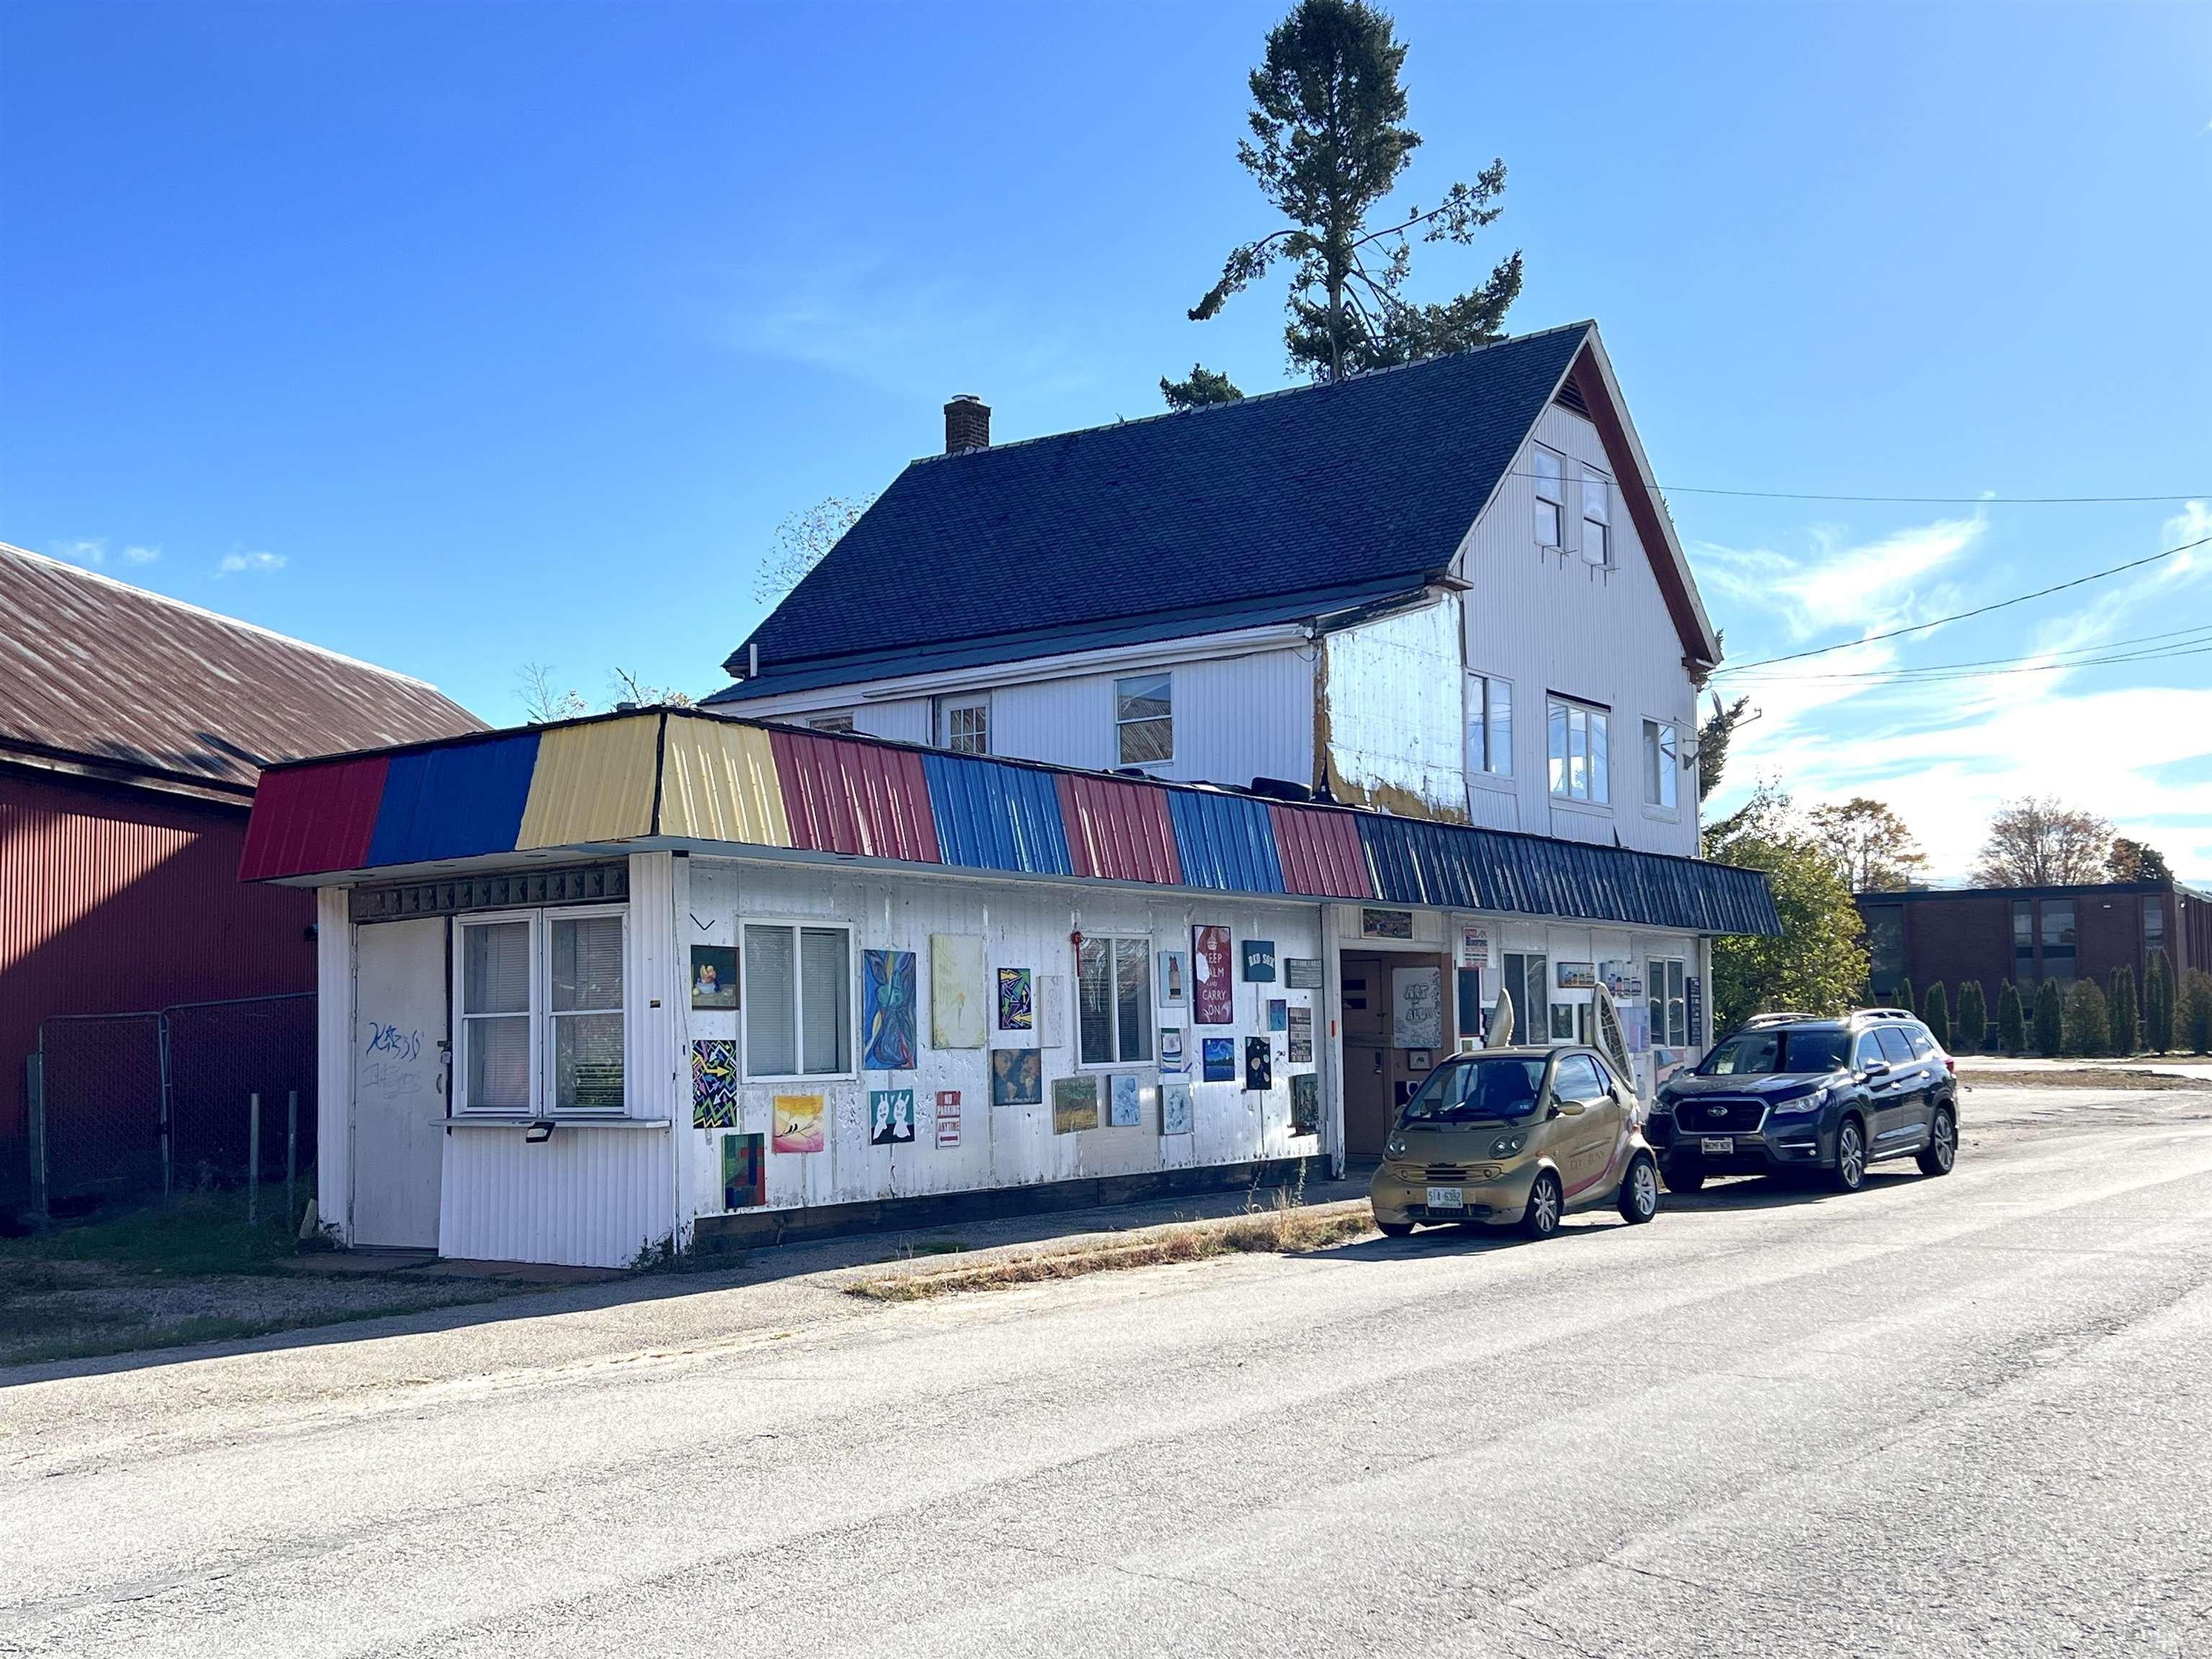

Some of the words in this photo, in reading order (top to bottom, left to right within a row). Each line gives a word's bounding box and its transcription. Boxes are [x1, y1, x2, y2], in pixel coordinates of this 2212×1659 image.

[1206, 952, 1223, 963] EEP
[1248, 953, 1261, 967] RED
[1208, 966, 1225, 978] ALM
[1202, 989, 1226, 1001] CARRY
[1405, 984, 1429, 1000] ART
[1208, 1004, 1221, 1016] ON
[937, 1105, 960, 1116] PARKING
[938, 1121, 960, 1132] ANYTIME
